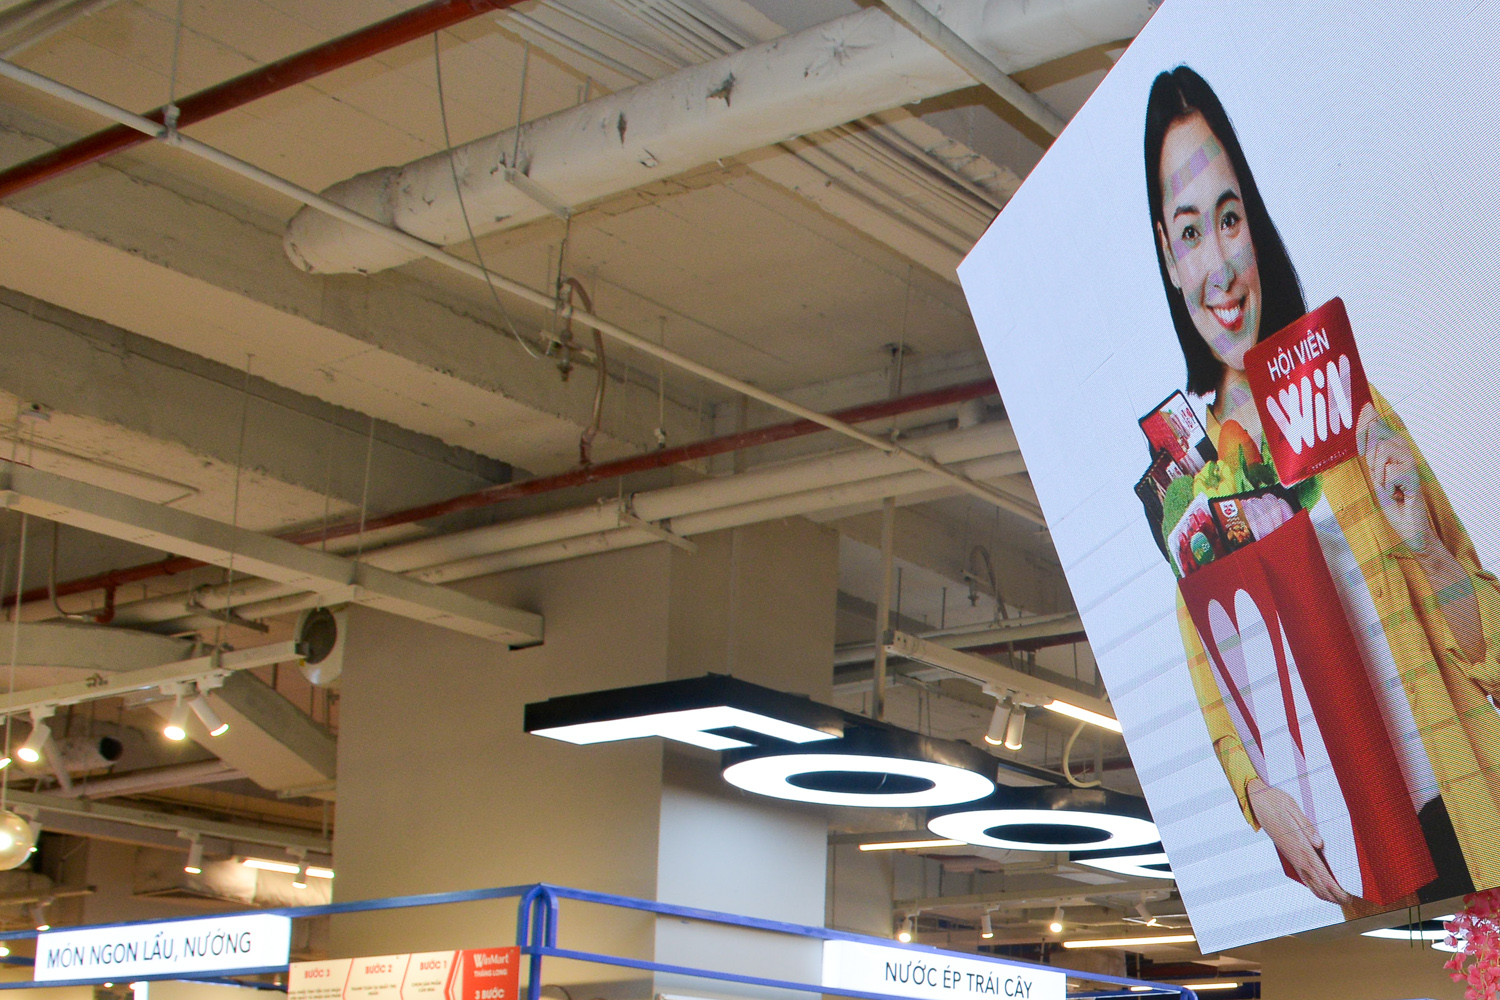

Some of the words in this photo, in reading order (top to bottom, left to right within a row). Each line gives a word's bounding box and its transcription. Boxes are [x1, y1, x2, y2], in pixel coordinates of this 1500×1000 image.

[1267, 341, 1295, 382] HỘI
[1296, 327, 1331, 362] VIÊN
[46, 942, 86, 969] MÓN
[89, 940, 139, 966] NGON
[142, 930, 179, 963] LẨU,
[184, 928, 252, 958] NƯỚNG
[420, 960, 441, 970] BƯỚC
[474, 953, 509, 967] WinMart
[304, 969, 325, 979] BƯỚC
[365, 964, 386, 974] BƯỚC
[387, 964, 392, 973] 2
[492, 969, 508, 977] LONG
[885, 959, 938, 987] NƯỚC
[943, 966, 962, 990] ÉP
[966, 971, 999, 995] TRÁI
[1004, 975, 1033, 999] CÂY
[475, 990, 480, 1000] 3
[481, 986, 504, 999] BƯỚC
